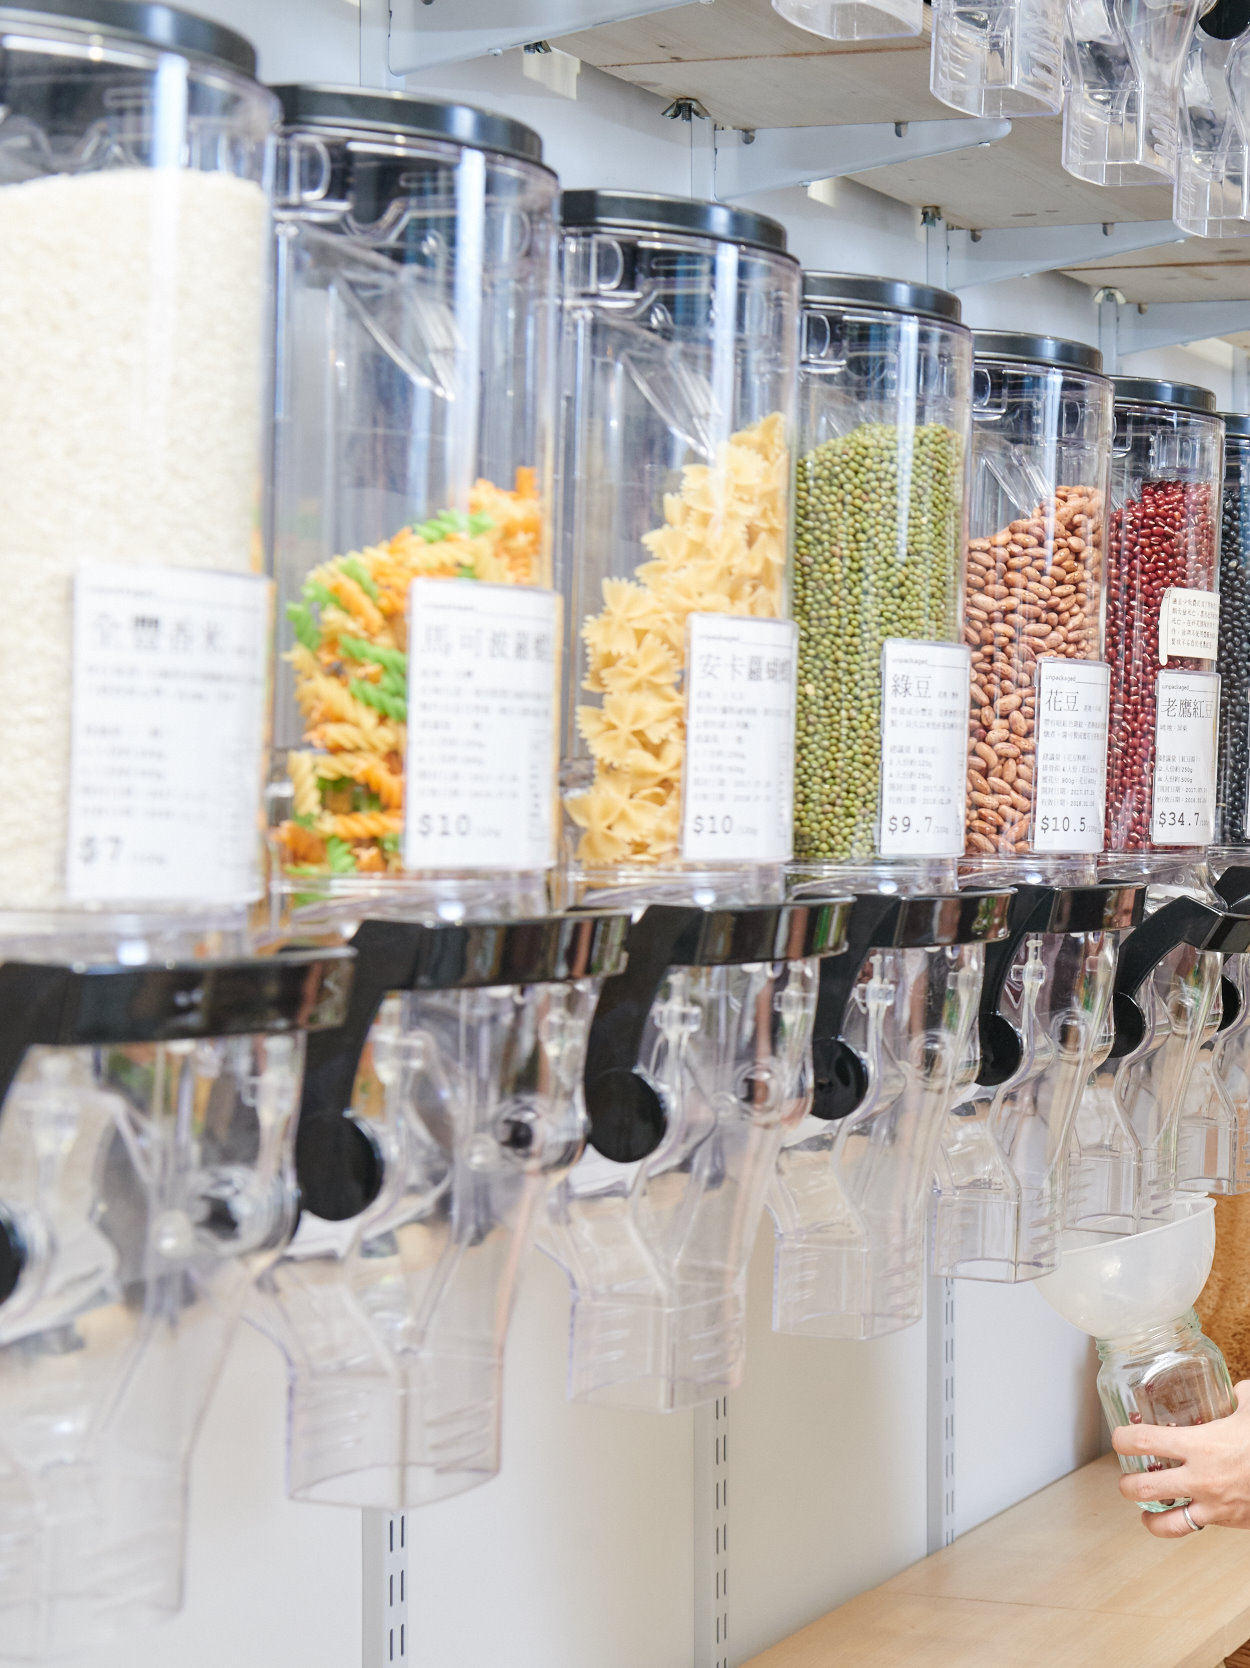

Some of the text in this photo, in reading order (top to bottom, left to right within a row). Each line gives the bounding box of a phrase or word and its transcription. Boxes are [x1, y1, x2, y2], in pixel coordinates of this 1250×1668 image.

[891, 673, 932, 698] 綠豆
[1045, 689, 1079, 711] 花豆
[1161, 697, 1214, 719] 老鷹紅豆
[417, 813, 472, 838] $10
[692, 814, 734, 836] $10
[888, 815, 933, 836] $9.7
[1040, 815, 1086, 834] $10.5
[1158, 810, 1200, 828] $34.7
